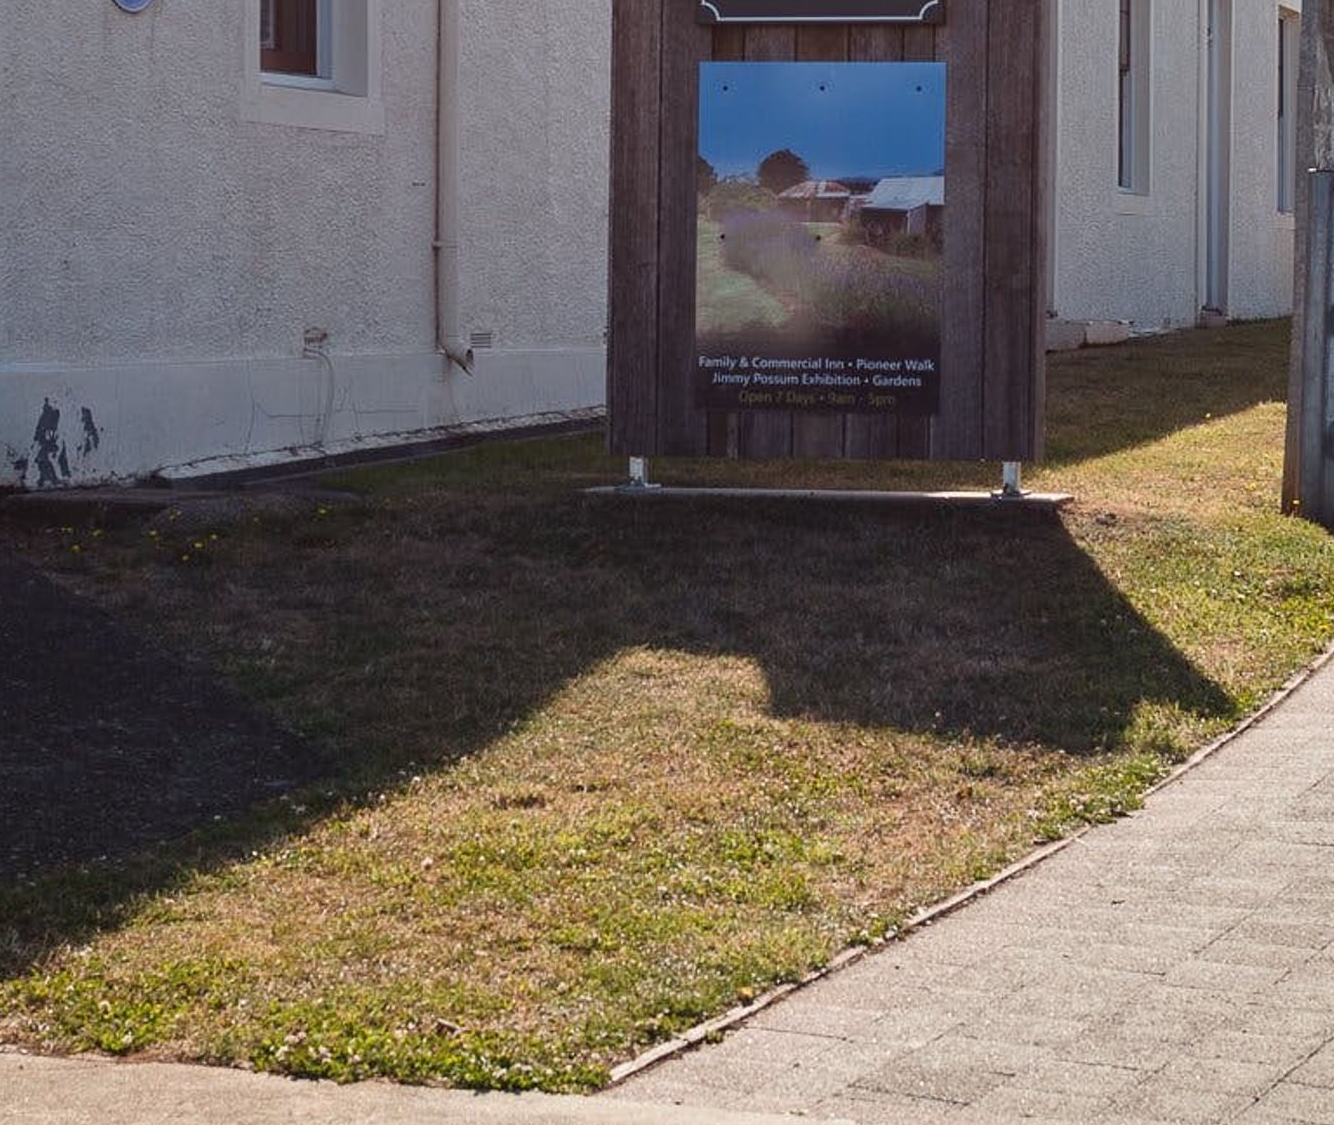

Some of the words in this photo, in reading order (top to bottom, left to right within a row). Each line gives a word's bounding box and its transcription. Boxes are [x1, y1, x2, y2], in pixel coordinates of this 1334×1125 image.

[698, 356, 736, 370] Family
[739, 357, 749, 368] &
[751, 357, 822, 369] Commercial
[825, 358, 845, 369] Inn
[856, 358, 901, 370] Pioneer
[905, 359, 935, 371] Walk
[712, 372, 750, 387] Jimmy
[754, 373, 800, 385] Possum
[802, 373, 861, 385] Exhibition
[872, 375, 923, 387] Gardens
[738, 390, 773, 406] Open
[786, 391, 815, 406] Days
